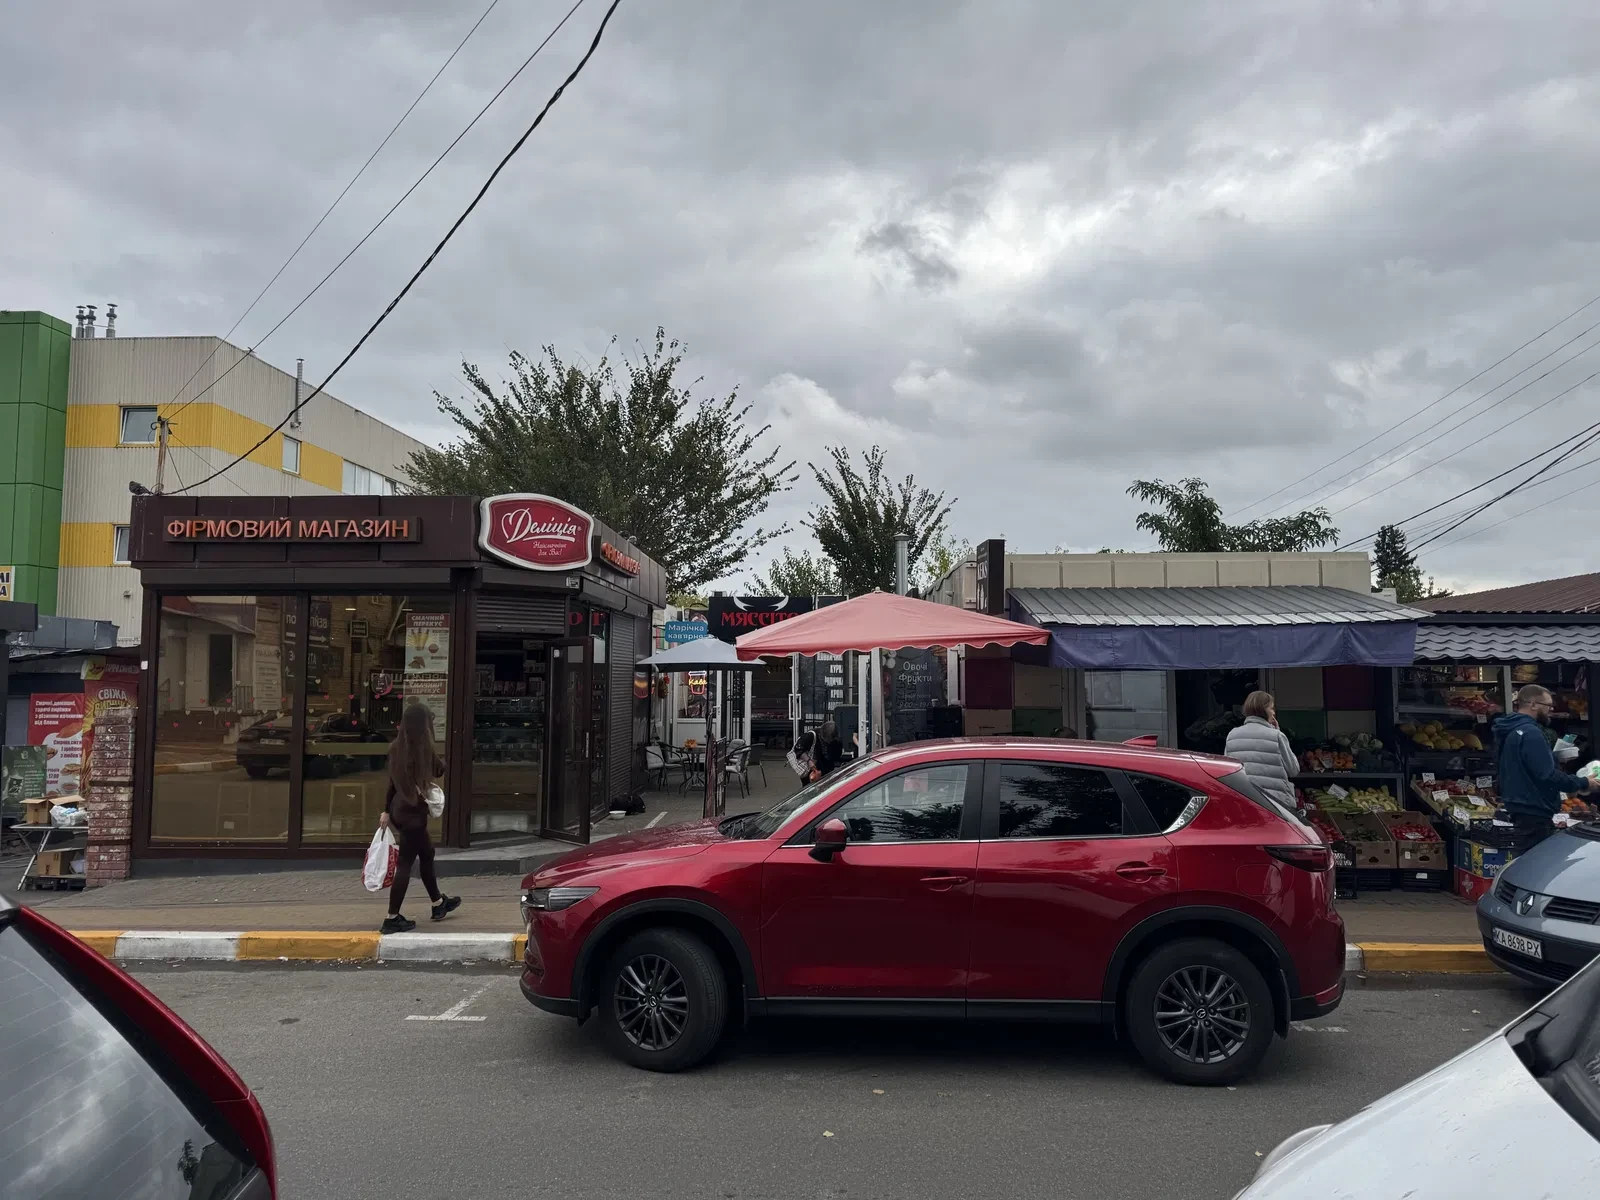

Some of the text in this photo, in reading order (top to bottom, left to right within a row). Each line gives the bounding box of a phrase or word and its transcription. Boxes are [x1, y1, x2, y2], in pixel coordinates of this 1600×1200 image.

[167, 517, 408, 538] ФІРМОВИЙ МАГАЗИН
[501, 507, 577, 543] Деліція
[668, 623, 705, 633] Марічка
[903, 661, 928, 671] Овочі
[898, 673, 932, 685] Фрукти
[98, 688, 128, 701] СВІЖА
[1526, 940, 1541, 958] PX
